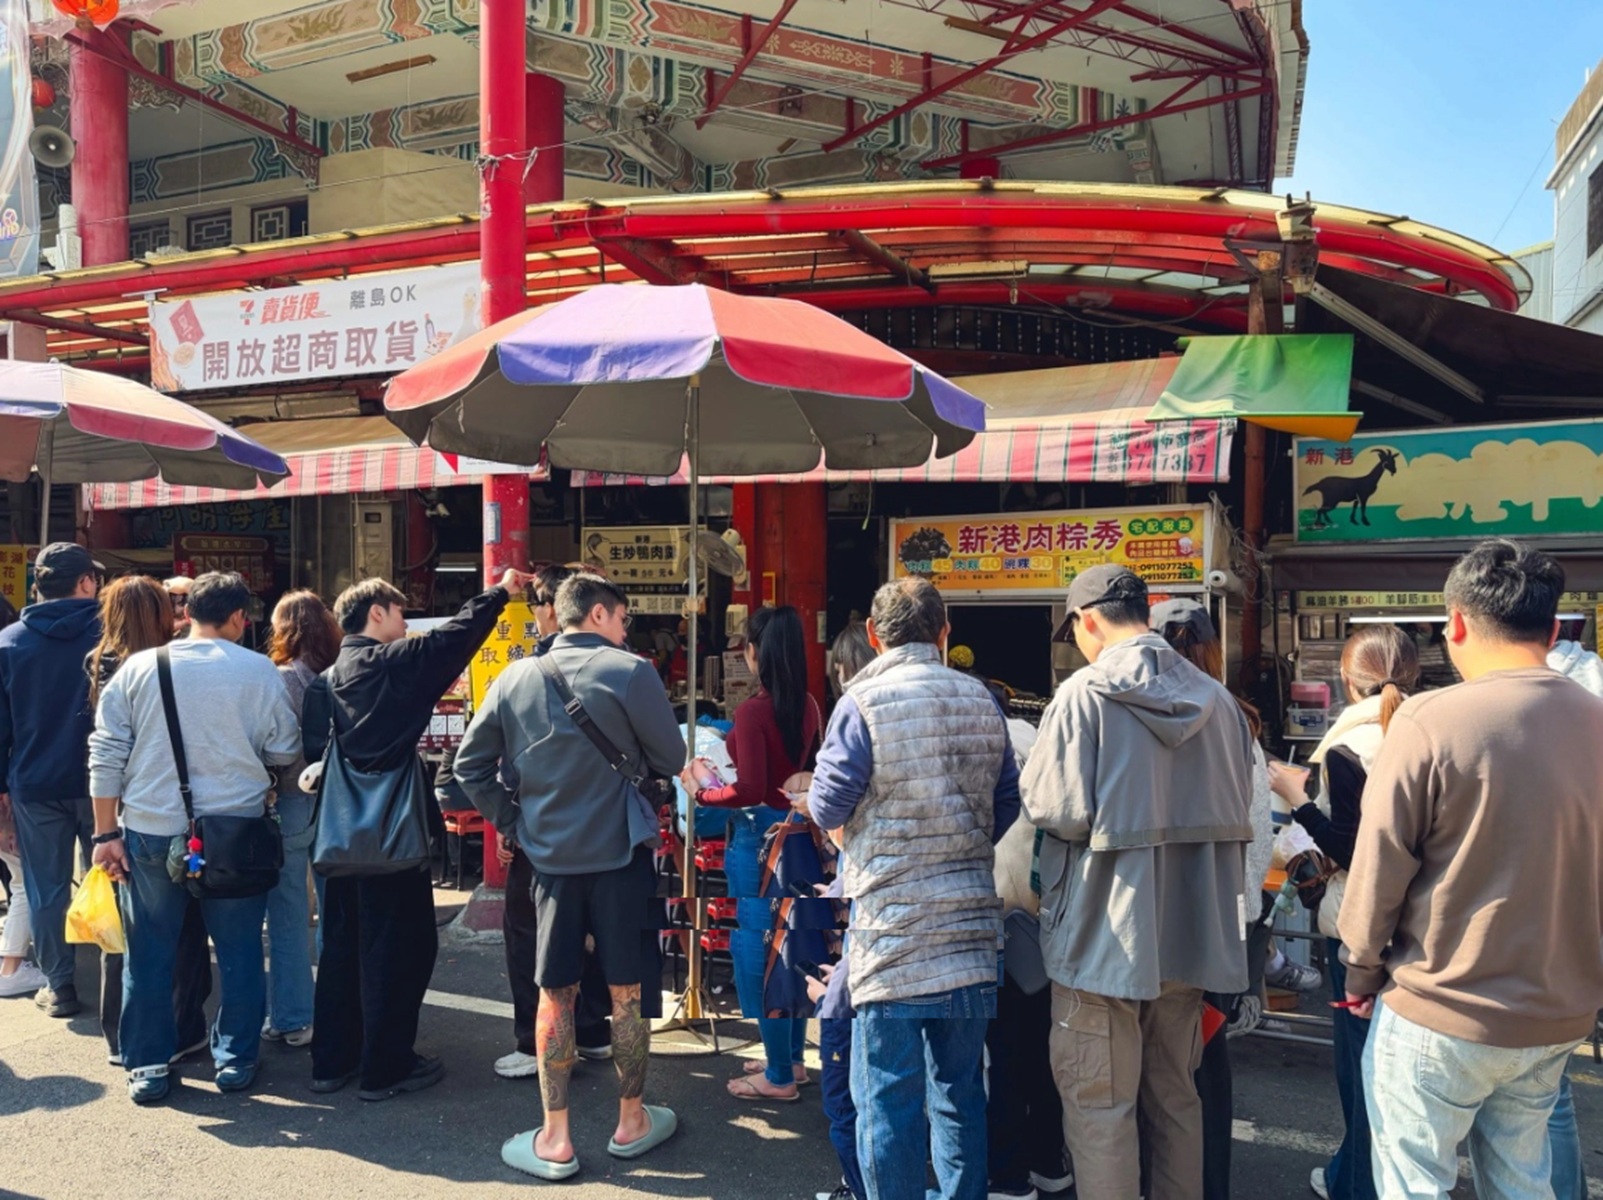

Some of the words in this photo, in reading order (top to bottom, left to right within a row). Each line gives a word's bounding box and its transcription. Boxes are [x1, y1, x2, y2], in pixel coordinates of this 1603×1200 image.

[260, 291, 323, 325] 賣貨便
[202, 320, 419, 382] 開放超商取貨
[1306, 447, 1354, 465] 新港
[1130, 517, 1192, 534] 宅配服務
[958, 519, 1124, 555] 新港肉粽秀
[934, 560, 950, 570] 45
[981, 558, 1000, 569] 40
[1032, 557, 1051, 567] 30
[495, 620, 542, 641] 重點
